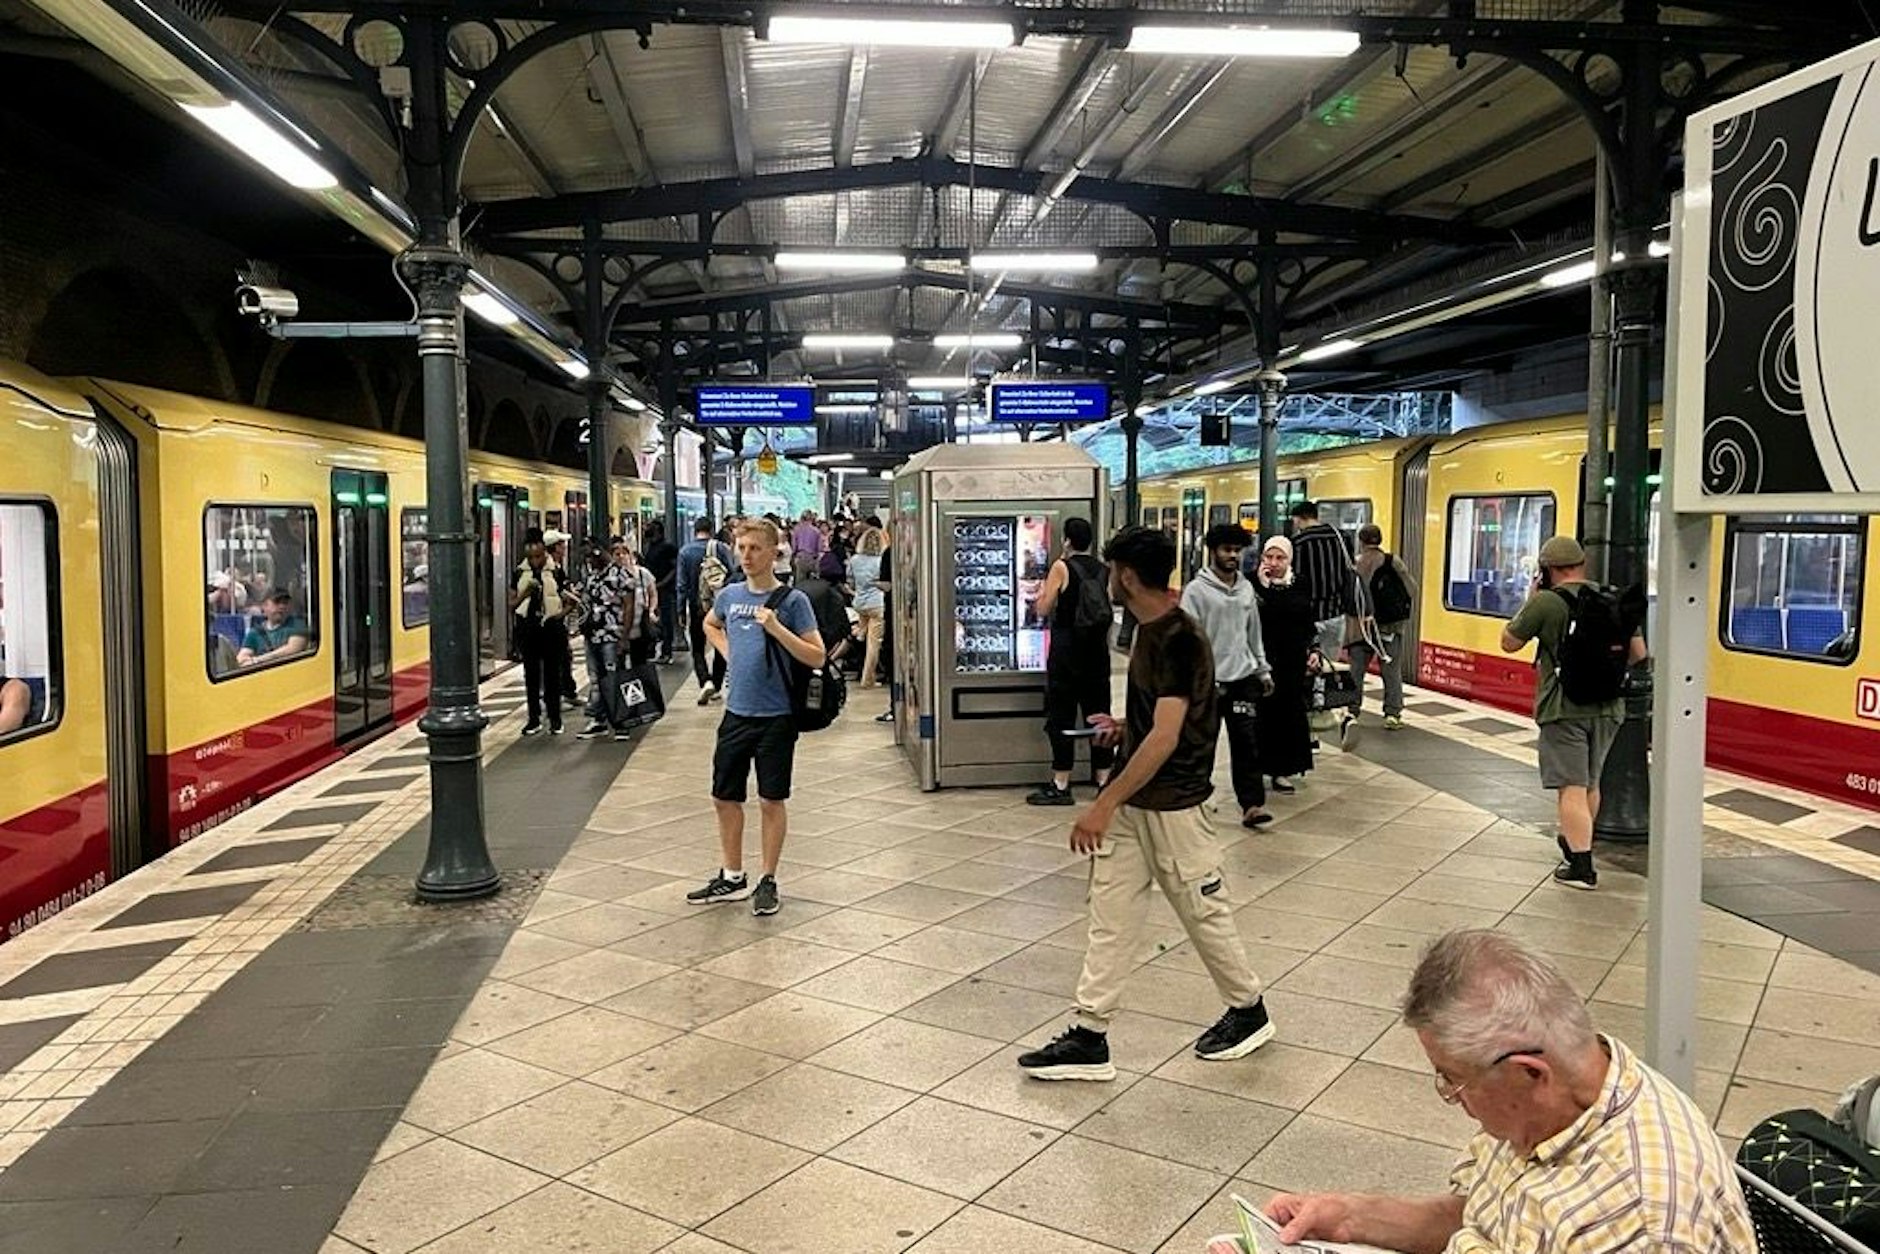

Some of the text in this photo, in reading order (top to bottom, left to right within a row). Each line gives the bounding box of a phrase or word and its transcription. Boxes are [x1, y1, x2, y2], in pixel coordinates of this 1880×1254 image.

[578, 417, 591, 444] 2
[1217, 417, 1228, 441] 1
[1845, 772, 1866, 791] 483
